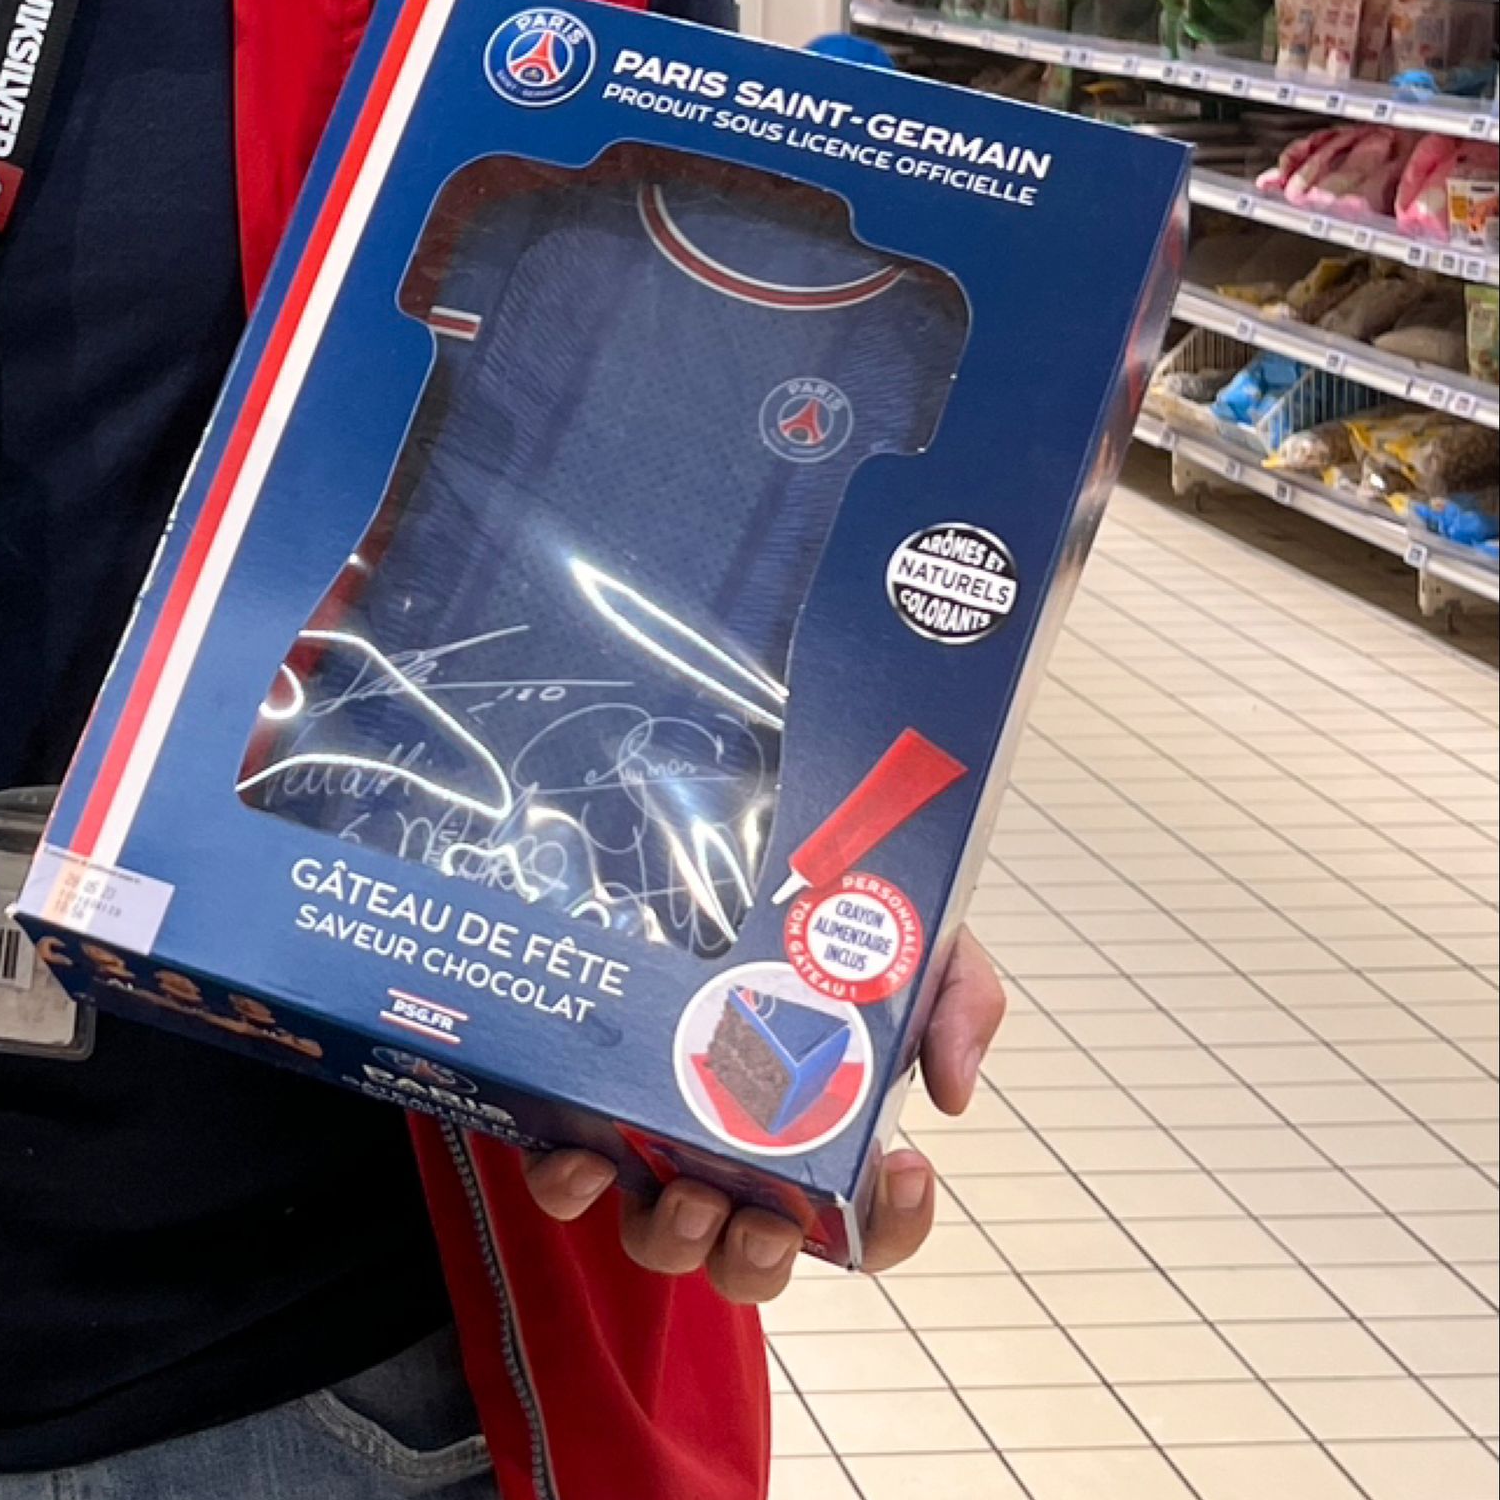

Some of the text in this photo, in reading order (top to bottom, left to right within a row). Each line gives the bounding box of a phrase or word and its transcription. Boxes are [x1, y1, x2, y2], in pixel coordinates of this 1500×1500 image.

[515, 12, 586, 45] PARIS
[612, 49, 1053, 181] PARIS SAINT-GERMAIN
[602, 83, 1039, 207] PRODUIT SOUS LICENCE OFFICIELLE
[916, 529, 1007, 573] ARÔMES ET
[897, 554, 1011, 606] NATURELS
[900, 589, 991, 633] COLORANTS
[291, 857, 631, 996] GÂTEAU DE FÊTE
[813, 915, 893, 956] ALIMENTAIRE
[835, 898, 886, 929] CRAYON
[295, 903, 596, 1023] SAVEUR CHOCOLAT
[823, 942, 868, 972] INCLUS
[392, 999, 456, 1032] PSG.FR
